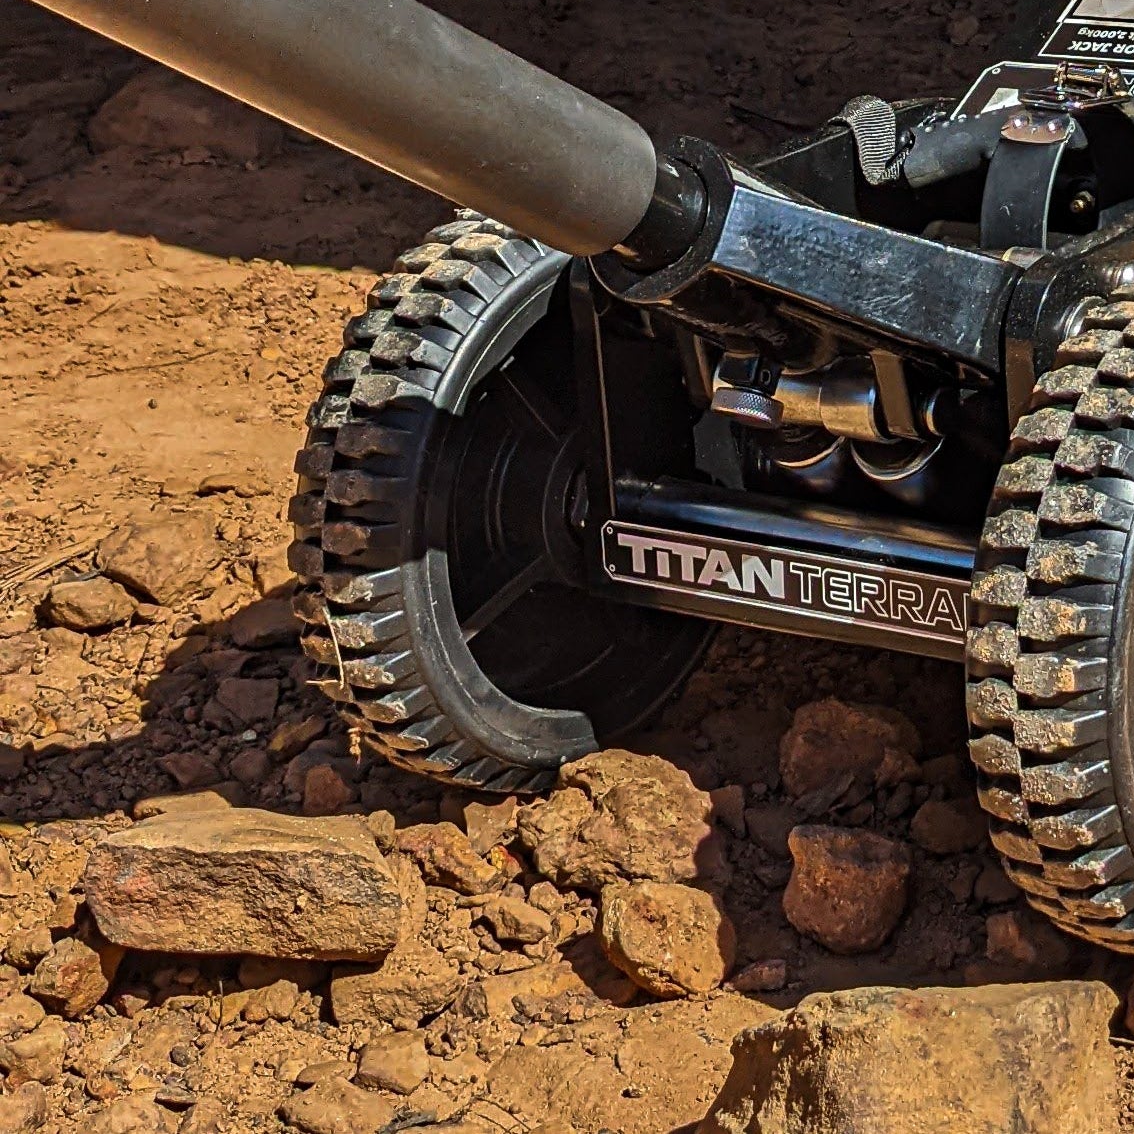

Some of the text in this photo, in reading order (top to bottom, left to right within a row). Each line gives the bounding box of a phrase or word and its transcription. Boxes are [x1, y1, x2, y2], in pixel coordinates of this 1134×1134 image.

[1077, 27, 1127, 39] 2,000kg
[1068, 40, 1112, 52] JACK
[617, 532, 968, 632] TITAN TERRA
